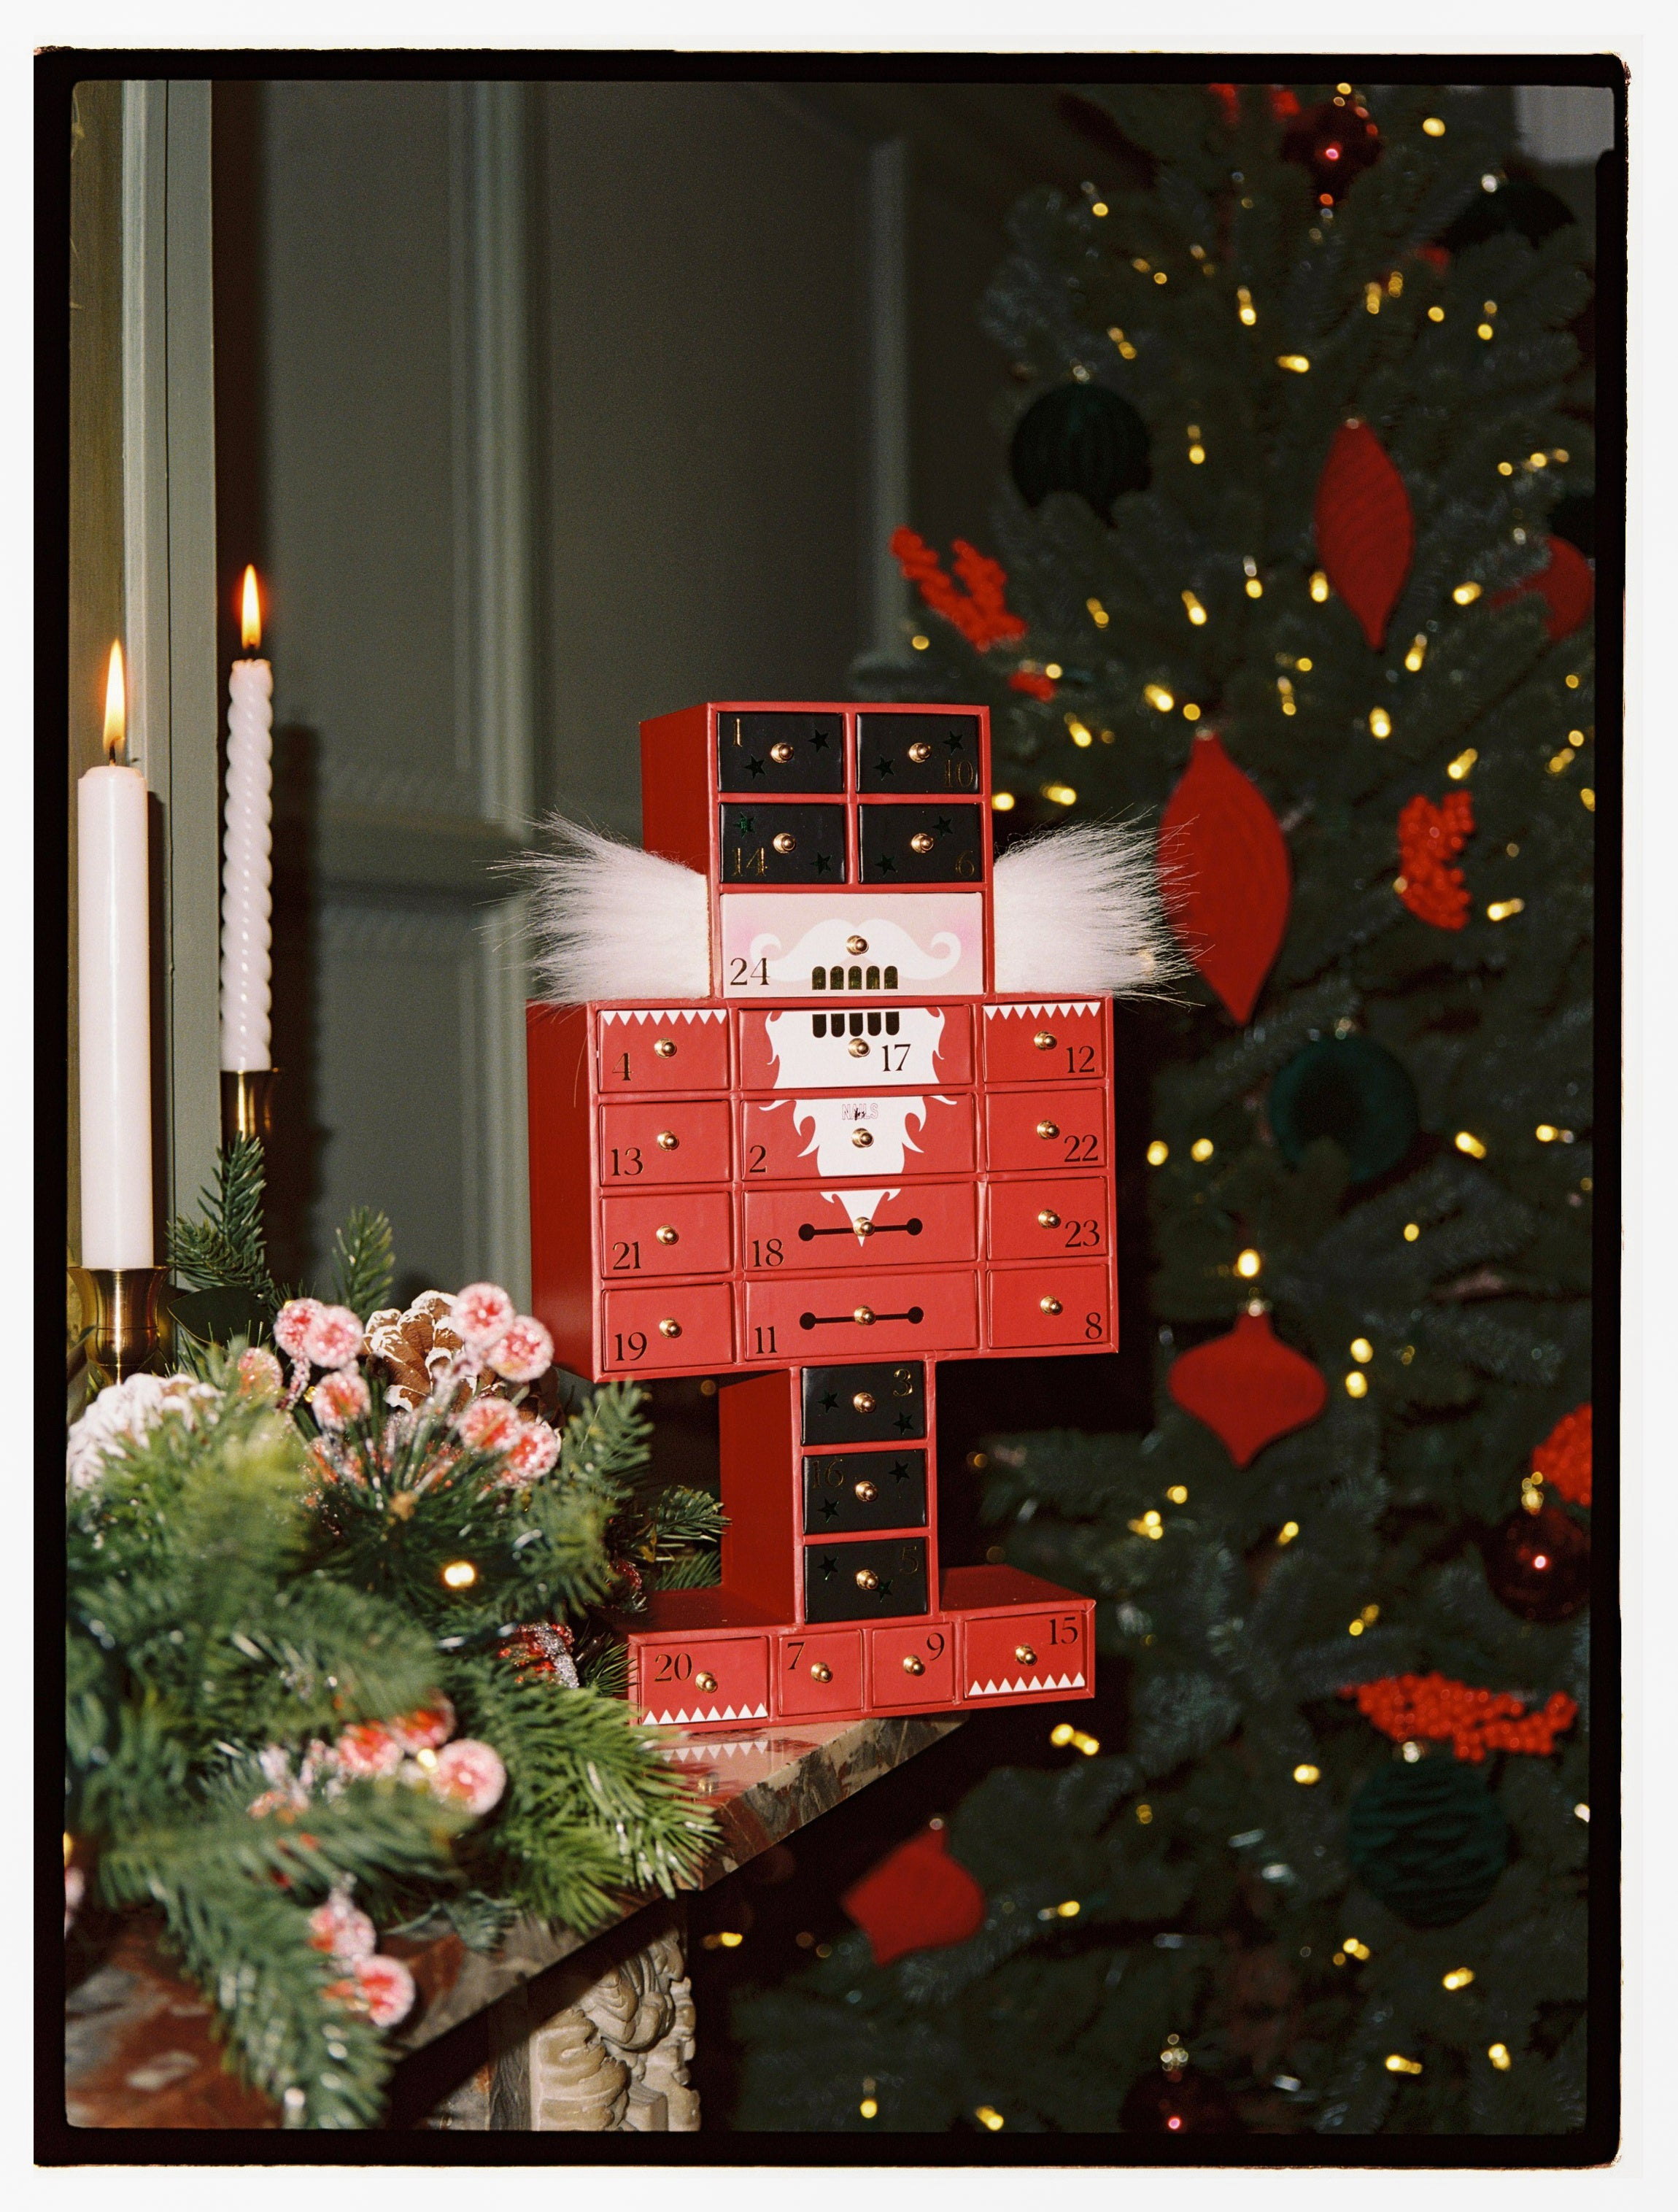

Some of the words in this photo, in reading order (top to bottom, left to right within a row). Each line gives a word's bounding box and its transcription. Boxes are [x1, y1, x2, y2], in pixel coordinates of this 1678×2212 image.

[732, 718, 743, 747] 1
[944, 759, 974, 788] 10
[733, 847, 768, 876] 14
[955, 851, 975, 876] 6
[730, 957, 770, 986] 24
[612, 1053, 633, 1080] 4
[882, 1043, 911, 1072] 17
[1066, 1045, 1095, 1073] 12
[842, 1103, 878, 1121] NAILS
[611, 1147, 643, 1176] 13
[749, 1145, 767, 1173] 2
[1064, 1134, 1098, 1162] 22
[1064, 1219, 1100, 1248] 23
[612, 1241, 641, 1270] 21
[752, 1238, 784, 1267] 18
[754, 1326, 777, 1354] 11
[1085, 1312, 1102, 1339] 8
[614, 1331, 647, 1361] 19
[892, 1369, 913, 1396] 3
[812, 1459, 844, 1489] 16
[900, 1546, 919, 1574] 5
[1047, 1617, 1078, 1645] 15
[787, 1641, 805, 1670] 7
[927, 1632, 945, 1660] 9
[654, 1652, 692, 1682] 20
